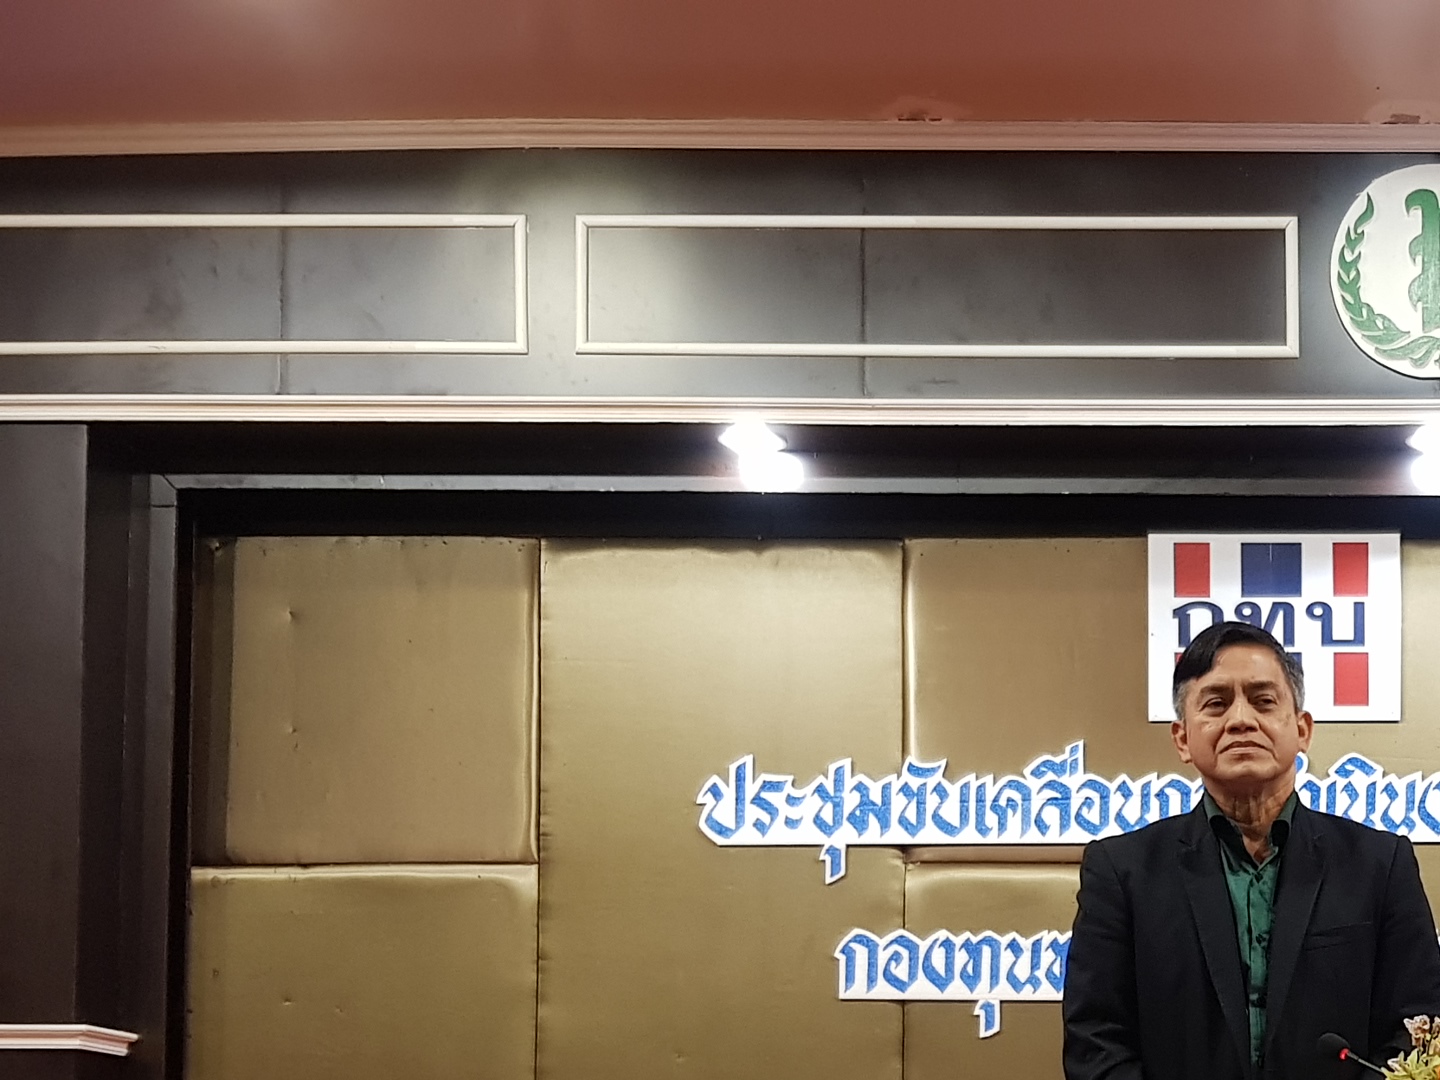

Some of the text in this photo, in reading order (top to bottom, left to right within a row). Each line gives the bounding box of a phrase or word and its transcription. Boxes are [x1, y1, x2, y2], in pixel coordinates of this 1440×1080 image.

[702, 743, 1204, 878] ประชุมขับเคลื่อนก
